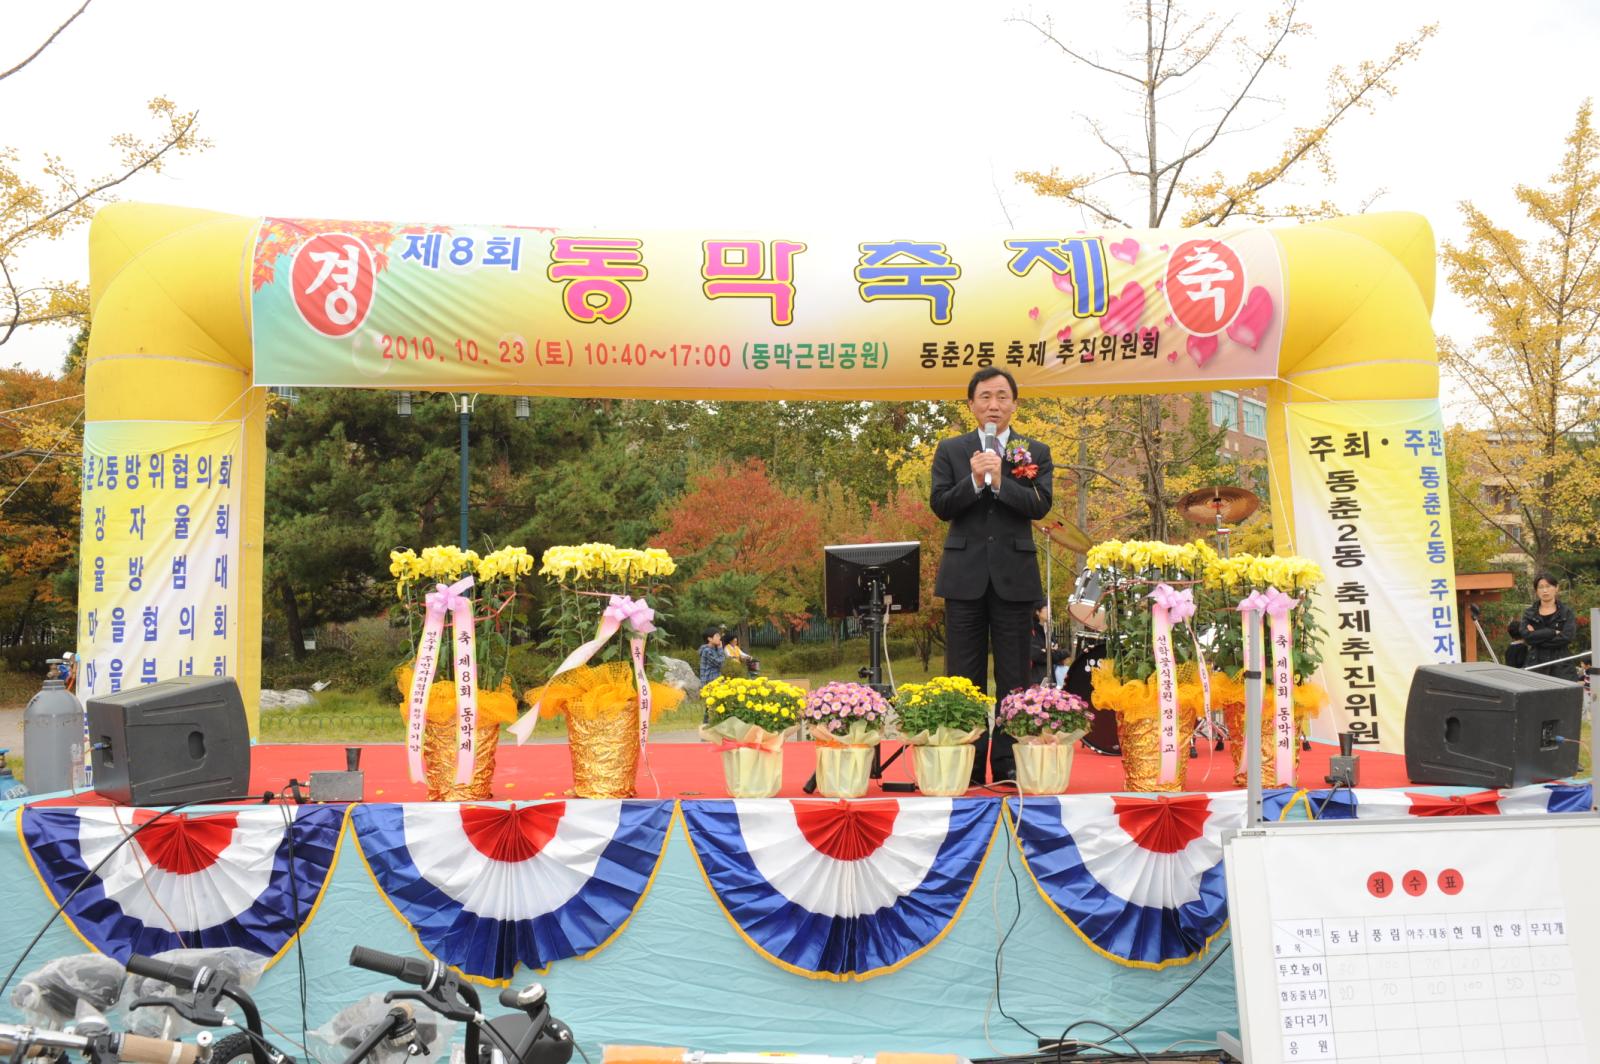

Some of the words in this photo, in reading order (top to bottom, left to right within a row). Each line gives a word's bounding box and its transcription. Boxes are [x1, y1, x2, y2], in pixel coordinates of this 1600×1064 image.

[402, 233, 522, 272] 제8회
[305, 244, 360, 325] 경
[1176, 236, 1232, 322] 축
[499, 341, 527, 364] 23
[535, 339, 575, 367] (토)
[741, 340, 891, 370] (동막근린공원)
[919, 338, 996, 369] 동춘2동
[1005, 340, 1046, 368] 축제
[1056, 331, 1160, 366] 추진위원회
[1325, 469, 1366, 569] 동춘2동
[1418, 465, 1447, 564] 동춘2동
[458, 631, 471, 645] 축
[1275, 634, 1289, 649] 축
[1429, 577, 1456, 664] 주민자
[458, 655, 472, 698] 제8회
[1276, 656, 1289, 699] 제8회
[459, 706, 474, 752] 동막제
[1277, 707, 1293, 750] 동막제
[1530, 921, 1565, 936] 무지개
[1279, 963, 1323, 977] 투호놀이
[1284, 1013, 1329, 1029] 줄다리기
